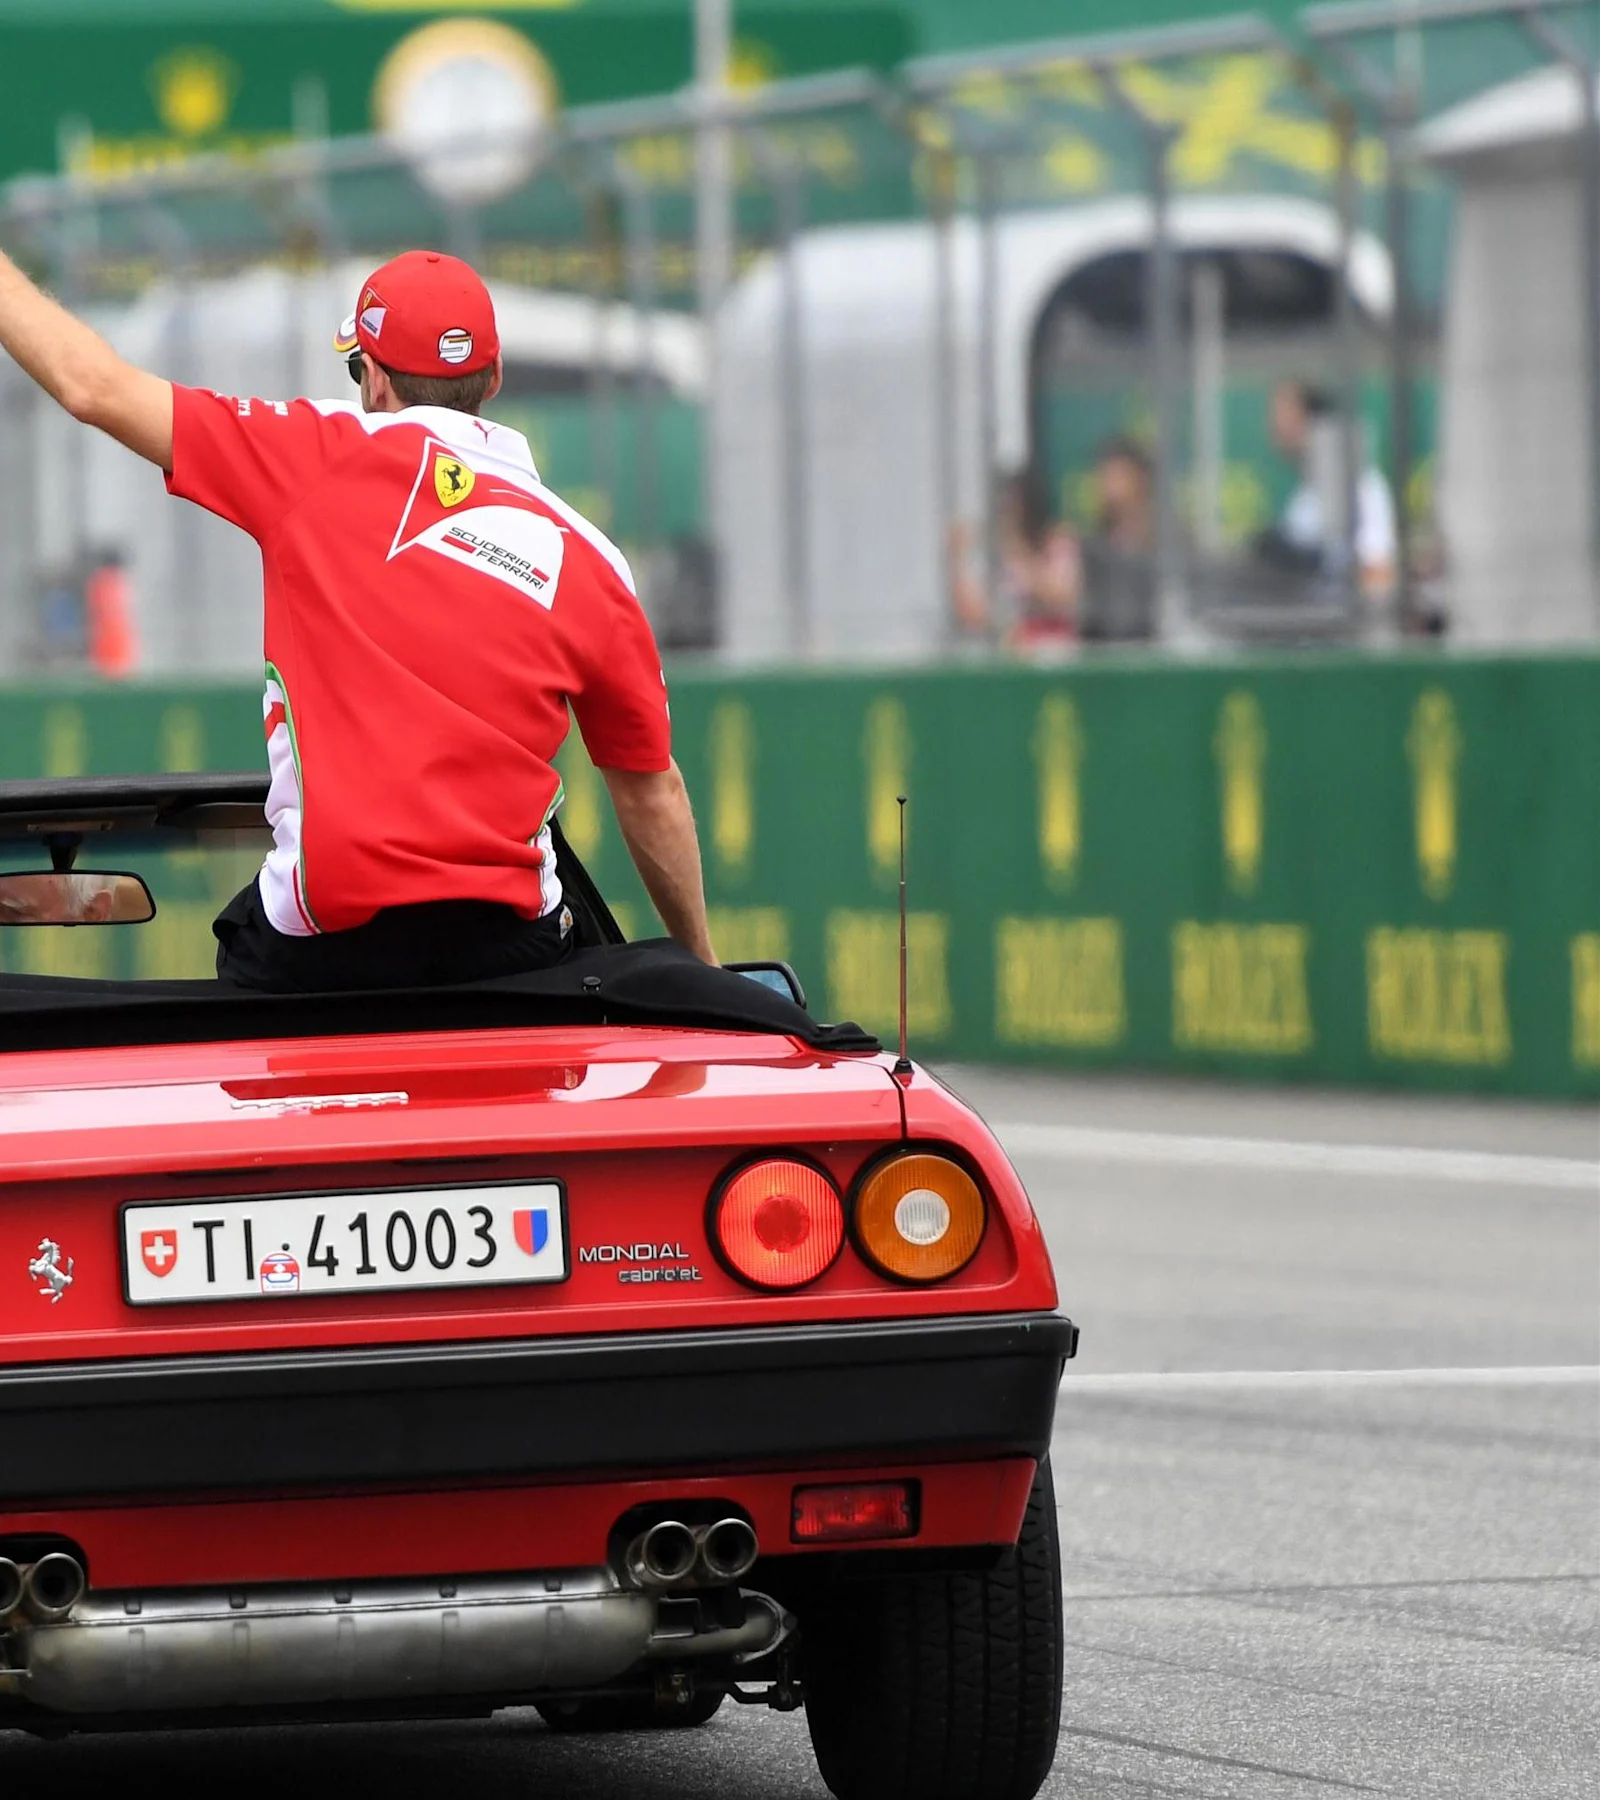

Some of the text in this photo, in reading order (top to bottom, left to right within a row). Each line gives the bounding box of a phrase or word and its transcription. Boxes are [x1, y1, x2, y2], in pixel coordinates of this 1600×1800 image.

[448, 526, 531, 571] SCUDERIA
[476, 549, 544, 590] FERRARI
[579, 1242, 689, 1263] MONDIAL
